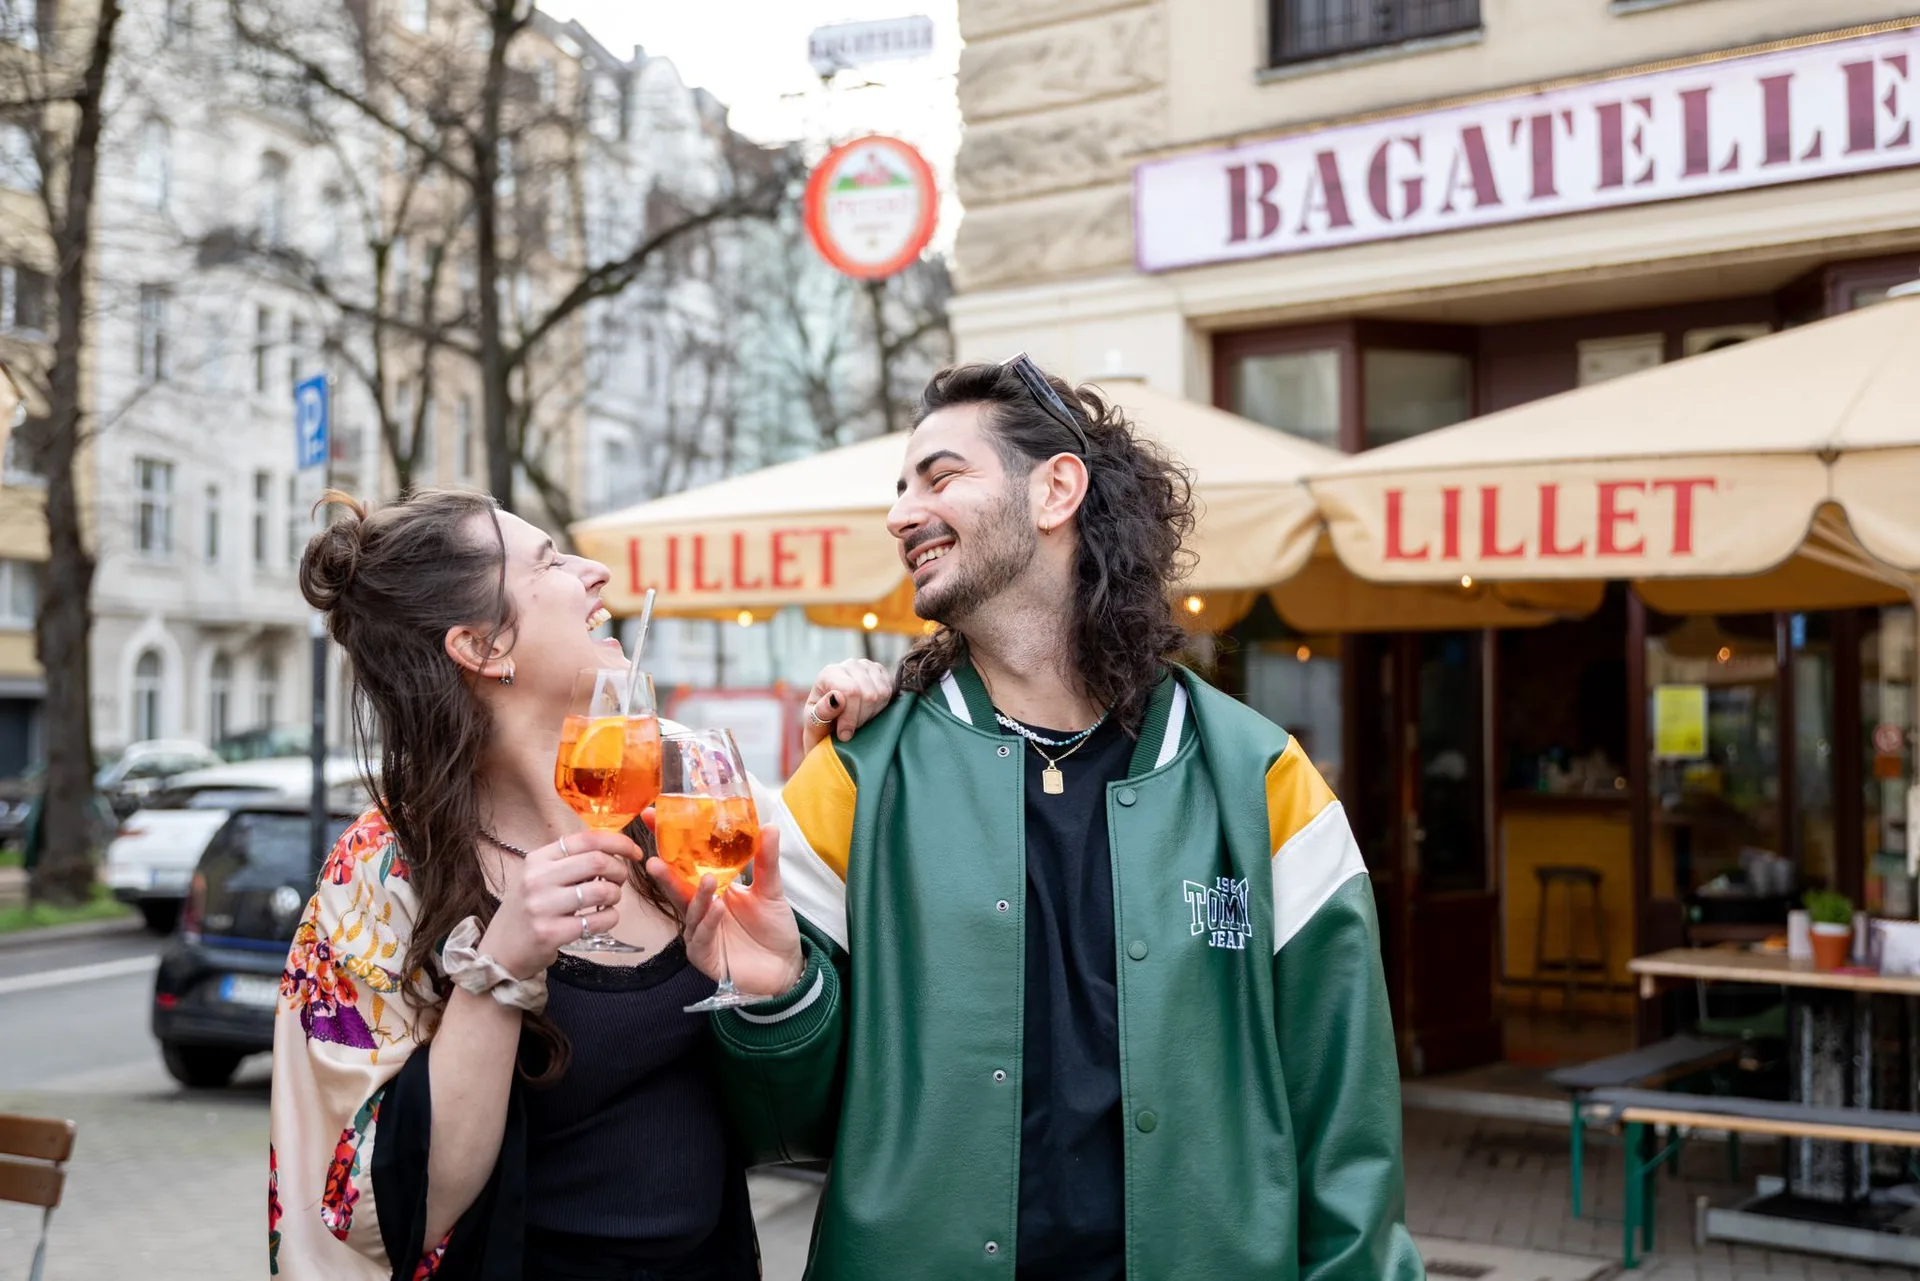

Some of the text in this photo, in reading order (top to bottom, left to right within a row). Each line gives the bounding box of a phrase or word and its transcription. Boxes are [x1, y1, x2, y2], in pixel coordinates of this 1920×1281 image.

[1222, 54, 1911, 246] BAGATELLE
[627, 527, 849, 597] LILLET
[1384, 477, 1717, 562] LILLET
